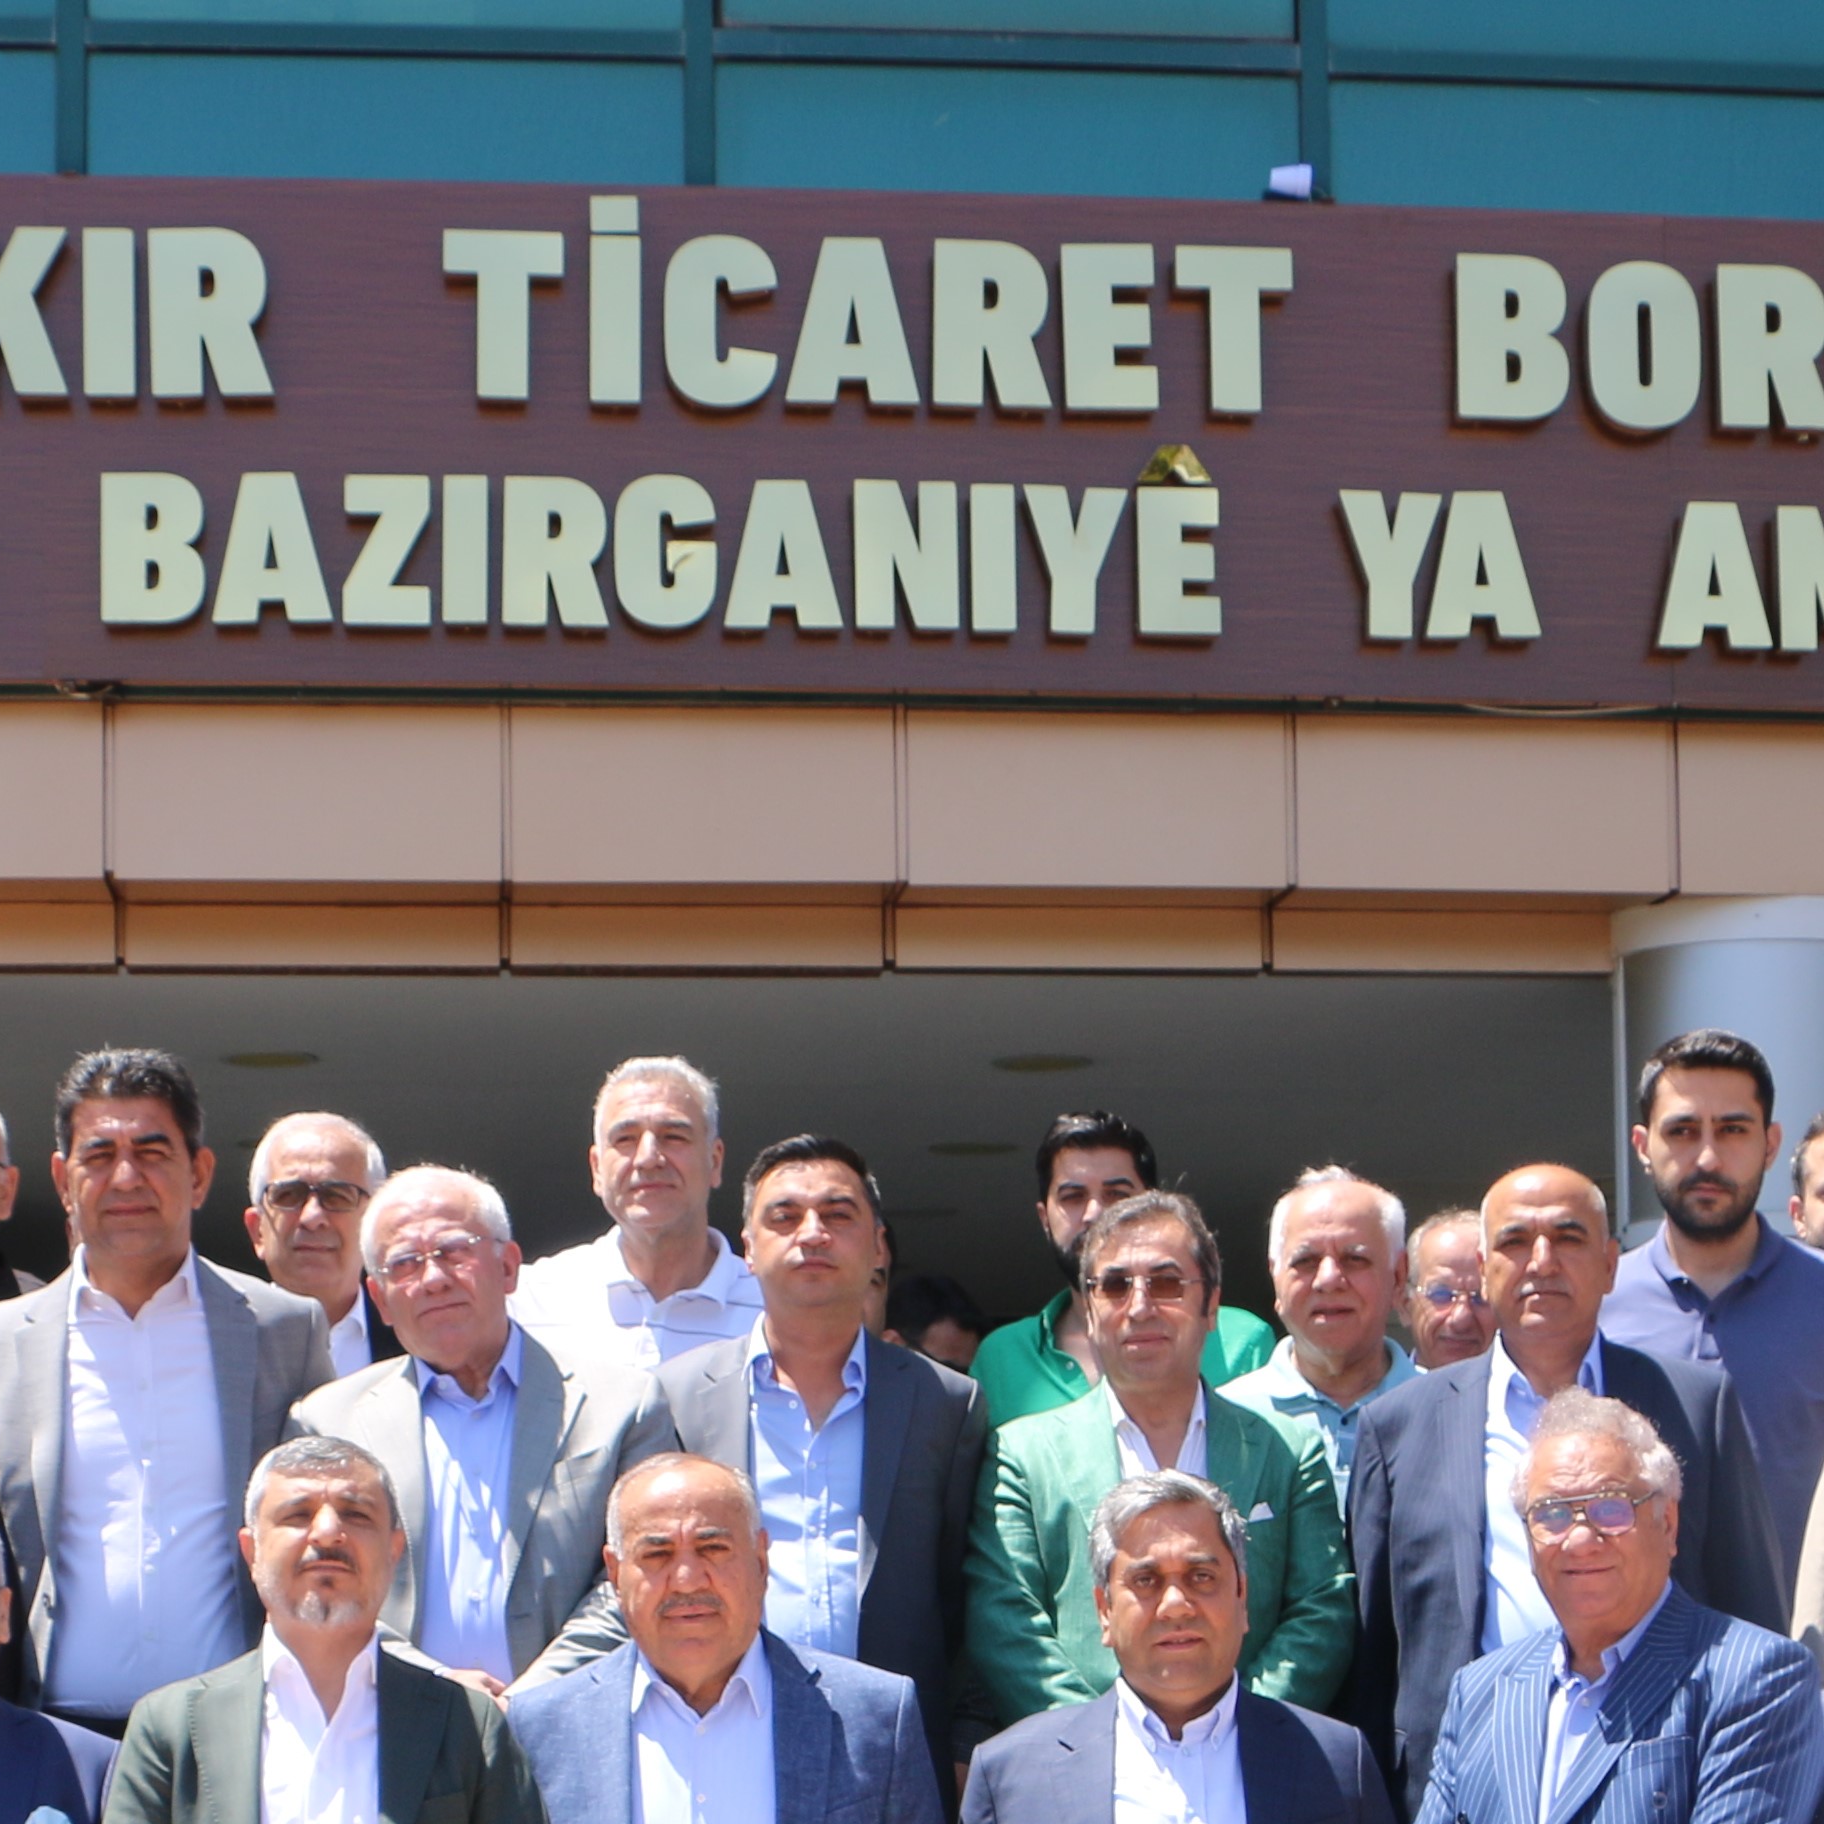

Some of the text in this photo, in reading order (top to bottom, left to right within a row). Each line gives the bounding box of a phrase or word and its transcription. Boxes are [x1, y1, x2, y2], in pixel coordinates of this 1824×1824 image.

[443, 195, 1293, 413] TİCARET
[101, 445, 1222, 636] BAZIRGANIYÊ
[1339, 489, 1542, 640] YA
